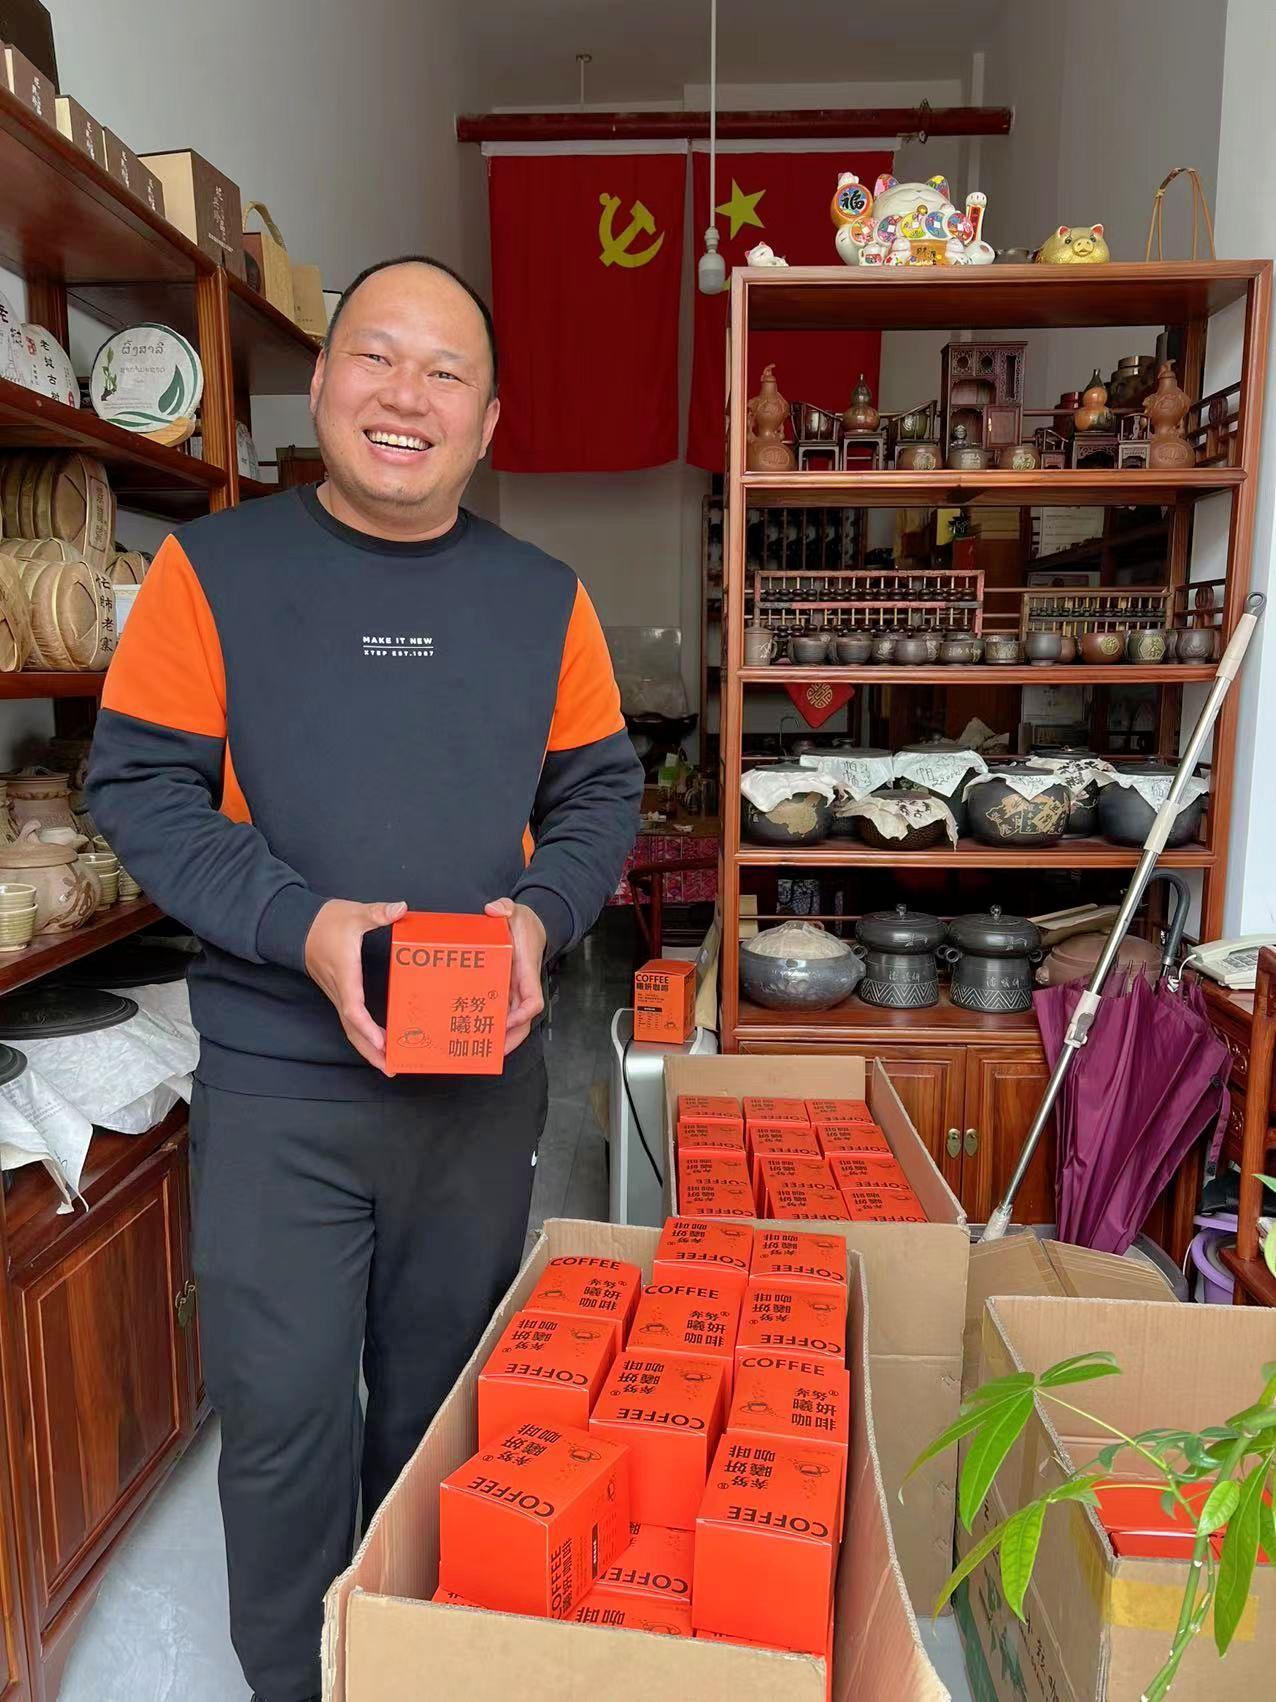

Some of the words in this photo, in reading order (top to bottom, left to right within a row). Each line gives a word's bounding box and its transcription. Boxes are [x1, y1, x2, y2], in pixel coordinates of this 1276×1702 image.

[362, 636, 392, 644] MAKE
[409, 637, 433, 645] NEW
[395, 947, 486, 969] COFFEE
[636, 974, 670, 984] COFFEE
[448, 1038, 493, 1058] 咖啡
[855, 1182, 910, 1190] COFFEE
[696, 1208, 754, 1217] COFFEE
[550, 1257, 621, 1270] COFFEE
[676, 1252, 746, 1268] COFFEE
[771, 1264, 845, 1281] COFFEE
[645, 1285, 720, 1300] COFFEE
[753, 1292, 792, 1303] 咖啡
[579, 1298, 617, 1311] 咖啡
[517, 1319, 558, 1330] 咖啡
[684, 1332, 725, 1347] 咖啡
[760, 1334, 842, 1354] COFFEE
[505, 1363, 588, 1386] COFFEE
[623, 1360, 664, 1372] 咖啡
[742, 1357, 825, 1376] COFFEE
[616, 1408, 705, 1430] COFFEE
[791, 1413, 837, 1431] 咖啡
[518, 1423, 562, 1443] 咖啡
[728, 1445, 776, 1462] 咖啡
[467, 1476, 555, 1518] COFFEE
[727, 1505, 829, 1538] COFFEE
[600, 1566, 689, 1594] COFFE
[576, 1606, 625, 1626] 咖啡
